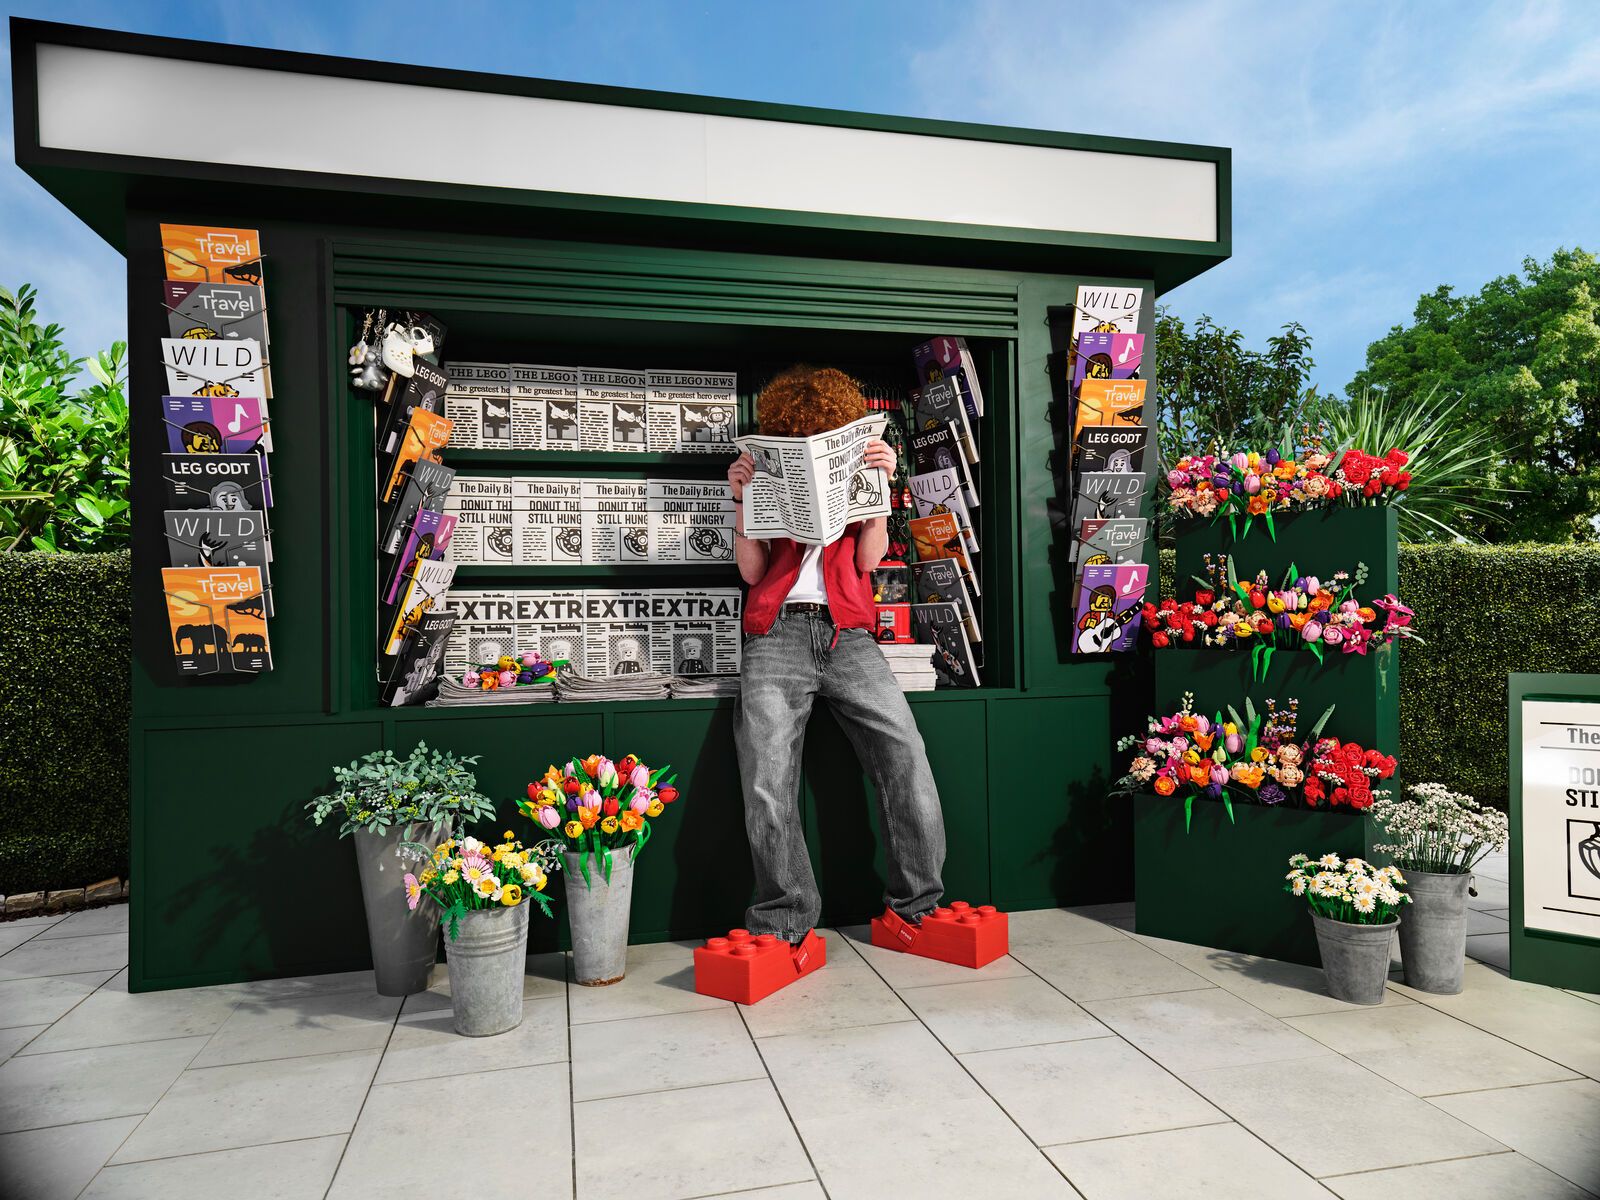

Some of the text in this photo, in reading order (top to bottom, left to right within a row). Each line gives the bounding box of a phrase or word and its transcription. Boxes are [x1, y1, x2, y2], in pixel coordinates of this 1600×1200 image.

[195, 238, 250, 256] Travel
[198, 295, 254, 312] Travel
[1083, 291, 1137, 310] WILD
[172, 346, 252, 366] WILD
[416, 364, 446, 388] LEG GODT
[449, 368, 506, 378] THE LEGO
[514, 370, 538, 379] THE
[541, 372, 570, 381] LEGO
[582, 374, 604, 382] THE
[608, 375, 636, 384] LEGO
[650, 376, 733, 386] THE LEGO NEWS
[469, 385, 499, 394] greatest
[534, 387, 562, 396] greatest
[668, 392, 696, 400] greatest
[924, 386, 954, 405] Travel
[1104, 388, 1140, 402] Travel
[429, 424, 450, 441] Travel
[825, 425, 872, 450] The Daily Brick
[913, 430, 949, 449] LEG GODT
[1088, 433, 1141, 444] LEG GODT
[829, 450, 850, 470] DONUT
[171, 463, 250, 475] LEG GODT
[829, 468, 848, 484] STILL
[419, 465, 452, 489] WILD
[459, 483, 476, 493] The
[478, 484, 501, 496] Daily
[528, 484, 544, 494] The
[546, 485, 569, 496] Daily
[596, 485, 612, 494] The
[614, 486, 636, 497] Daily
[663, 485, 725, 497] The Daily Brick
[912, 475, 952, 495] WILD
[1086, 478, 1140, 495] WILD
[460, 500, 493, 510] DONUT
[529, 501, 580, 511] DONUT THI
[598, 502, 628, 511] DONUT
[664, 502, 721, 512] DONUT THIEF
[459, 513, 486, 523] STILL
[528, 514, 581, 524] STILL HUNG
[597, 514, 622, 524] STILL
[663, 514, 725, 525] STILL HUNGRY
[174, 518, 255, 536] WILD
[925, 522, 953, 536] Travel
[1105, 528, 1141, 541] Travel
[420, 566, 453, 584] WILD
[927, 568, 955, 582] Travel
[197, 577, 253, 593] Travel
[517, 600, 584, 619] EXTR
[587, 600, 650, 618] EXTR
[652, 598, 740, 618] EXTRA!
[915, 608, 954, 624] WILD
[424, 620, 440, 630] LEG
[1567, 728, 1600, 744] The
[1566, 788, 1599, 808] STI
